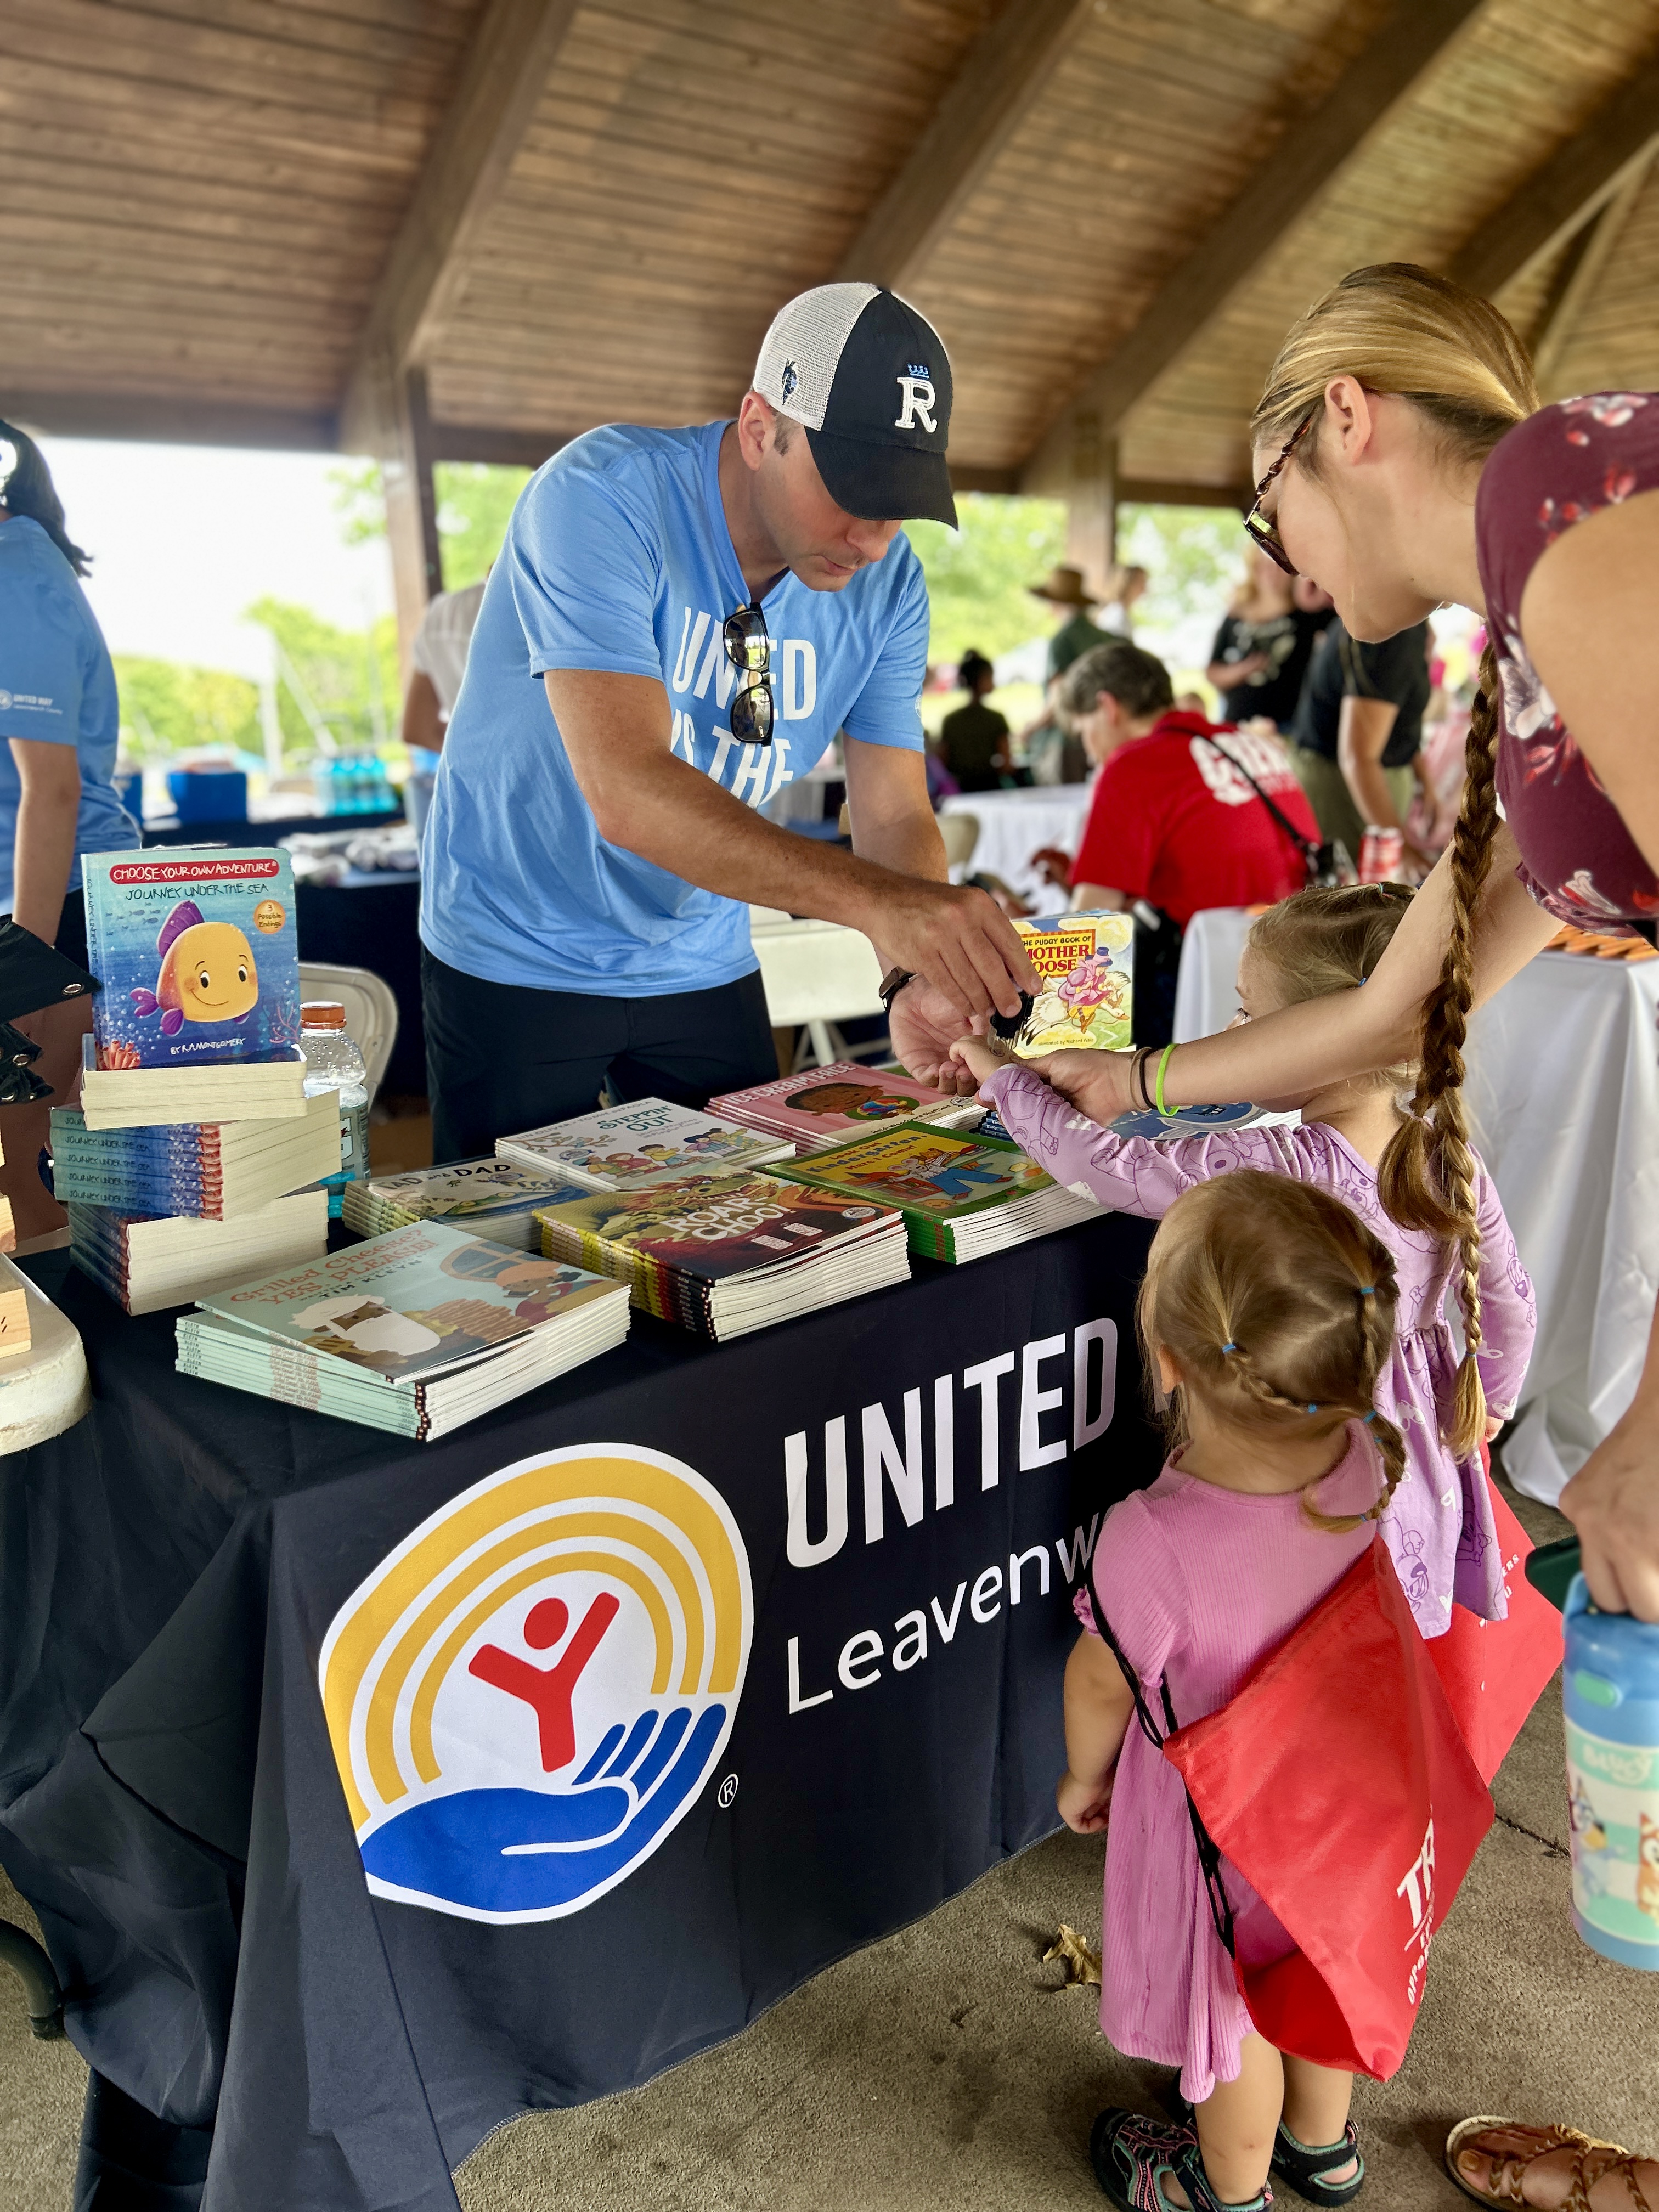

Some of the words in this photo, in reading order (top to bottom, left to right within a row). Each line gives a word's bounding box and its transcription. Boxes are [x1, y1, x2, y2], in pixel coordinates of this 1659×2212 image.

[895, 377, 938, 433] R
[708, 725, 794, 810] THE
[114, 867, 160, 880] CHOOSE
[161, 866, 191, 879] YOUR
[191, 865, 216, 876] OWN
[125, 887, 183, 900] JOURNEY
[185, 884, 221, 897] UNDER
[223, 883, 245, 894] THE
[247, 884, 269, 895] SEA
[1035, 938, 1058, 946] PUDGY
[170, 1047, 182, 1055] BY
[196, 1037, 246, 1051] MONTGOMERY
[723, 1092, 761, 1105] ICE
[752, 1075, 810, 1098] CREAM
[809, 1063, 859, 1083] FACE
[627, 1114, 674, 1131] OUT
[871, 1126, 890, 1134] Heidi
[923, 1104, 952, 1116] Sheffield
[65, 1136, 97, 1146] JOURNEY
[98, 1139, 122, 1148] UNDER
[806, 1135, 927, 1172] Kindergarten,
[830, 1149, 860, 1160] Look
[859, 1142, 882, 1150] Out
[66, 1154, 98, 1164] JOURNEY
[100, 1158, 121, 1167] UNDER
[845, 1159, 875, 1170] Here
[881, 1144, 917, 1158] Come!
[68, 1173, 99, 1183] JOURNEY
[100, 1176, 121, 1185] UNDER
[377, 1177, 424, 1190] TAD
[426, 1172, 452, 1181] and
[453, 1164, 511, 1177] DAD
[69, 1190, 100, 1200] JOURNEY
[100, 1194, 121, 1203] UNDER
[692, 1203, 797, 1240] CHOO!
[230, 1268, 325, 1303] Grilled
[325, 1229, 426, 1269] Cheese?
[330, 1239, 439, 1282] PLEASE!
[319, 1284, 356, 1298] TIM
[362, 1260, 423, 1283] KLEYN
[784, 1318, 1118, 1568] UNITED
[788, 1502, 1115, 1714] Leavenw
